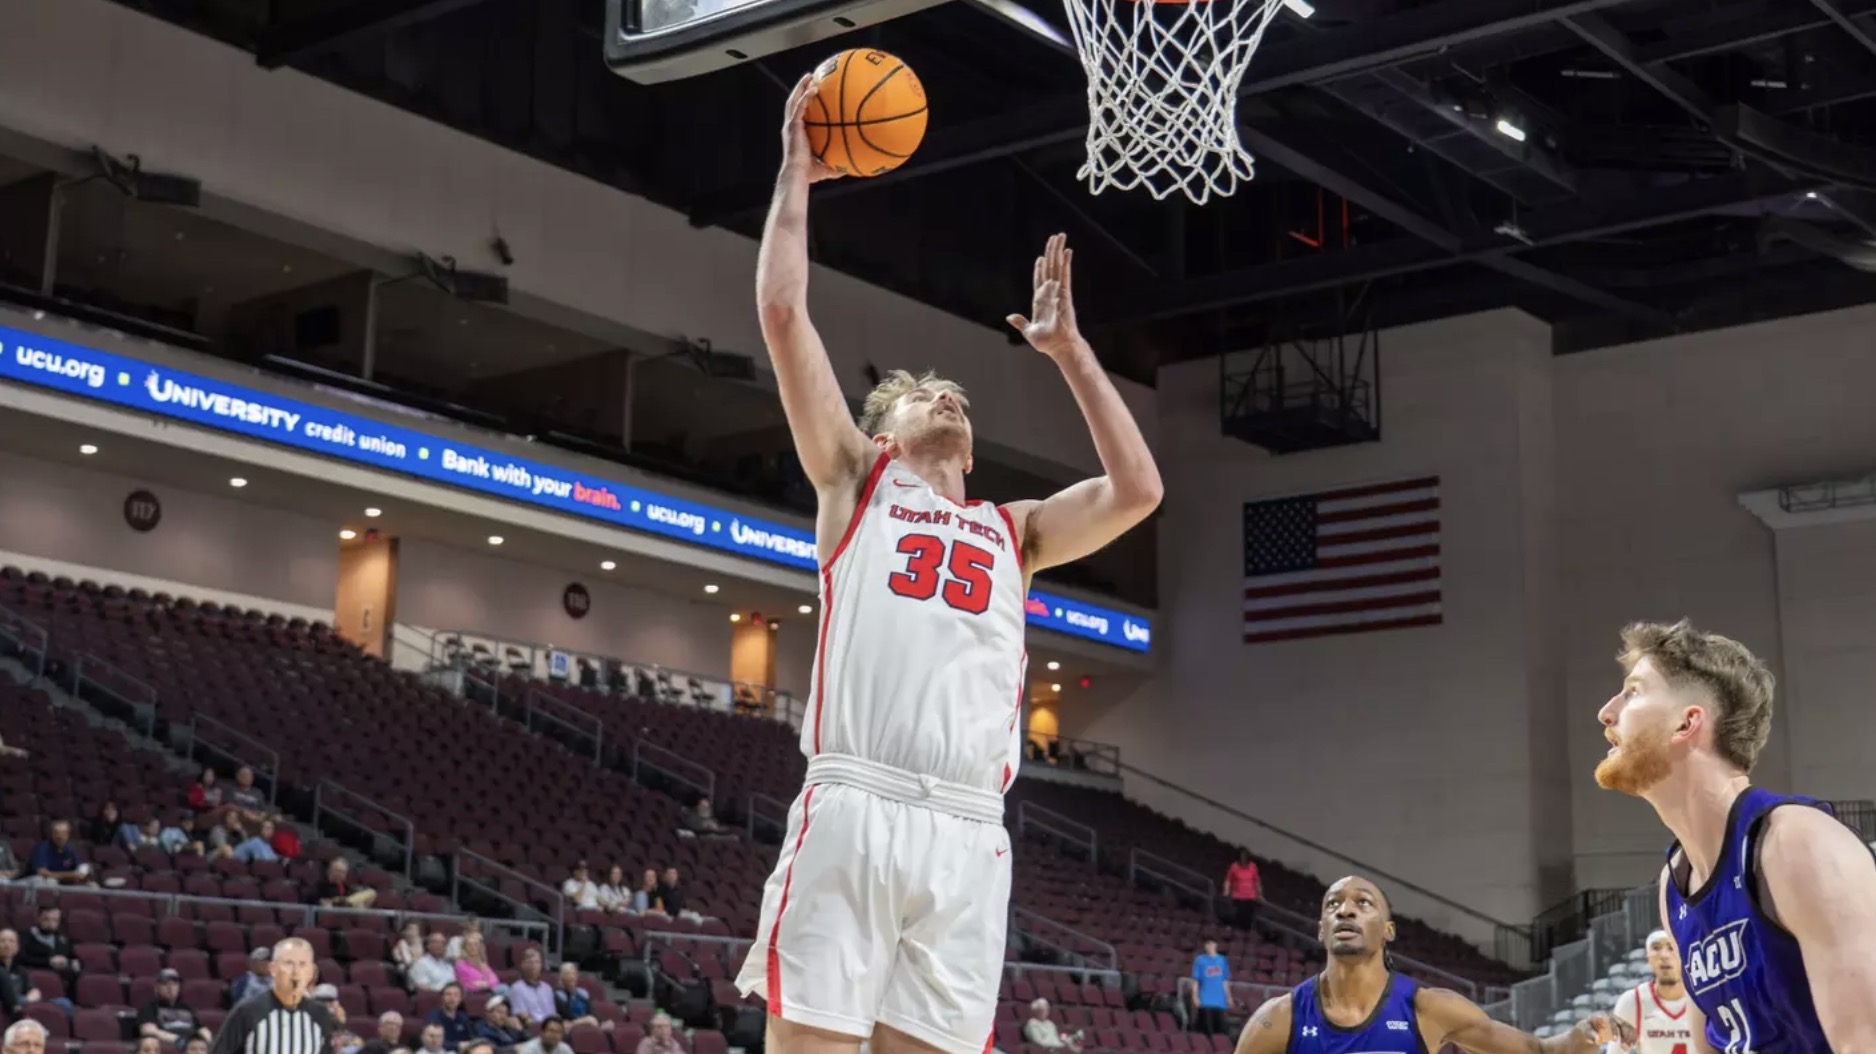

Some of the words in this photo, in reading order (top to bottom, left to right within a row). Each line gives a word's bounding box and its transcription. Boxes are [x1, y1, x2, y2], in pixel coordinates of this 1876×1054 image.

[16, 346, 105, 387] ucu.org
[144, 369, 300, 432] UNIVERSITY
[304, 421, 356, 447] credit
[358, 434, 406, 459] union
[442, 448, 490, 478] Bank
[491, 463, 531, 489] with
[532, 475, 573, 497] your
[573, 481, 622, 511] brain.
[646, 503, 706, 535] ucu.org
[888, 504, 952, 526] UTAH
[955, 514, 1006, 552] TECH
[887, 533, 995, 616] 35
[1066, 610, 1109, 635] ucu.org
[1690, 931, 1741, 986] ACU
